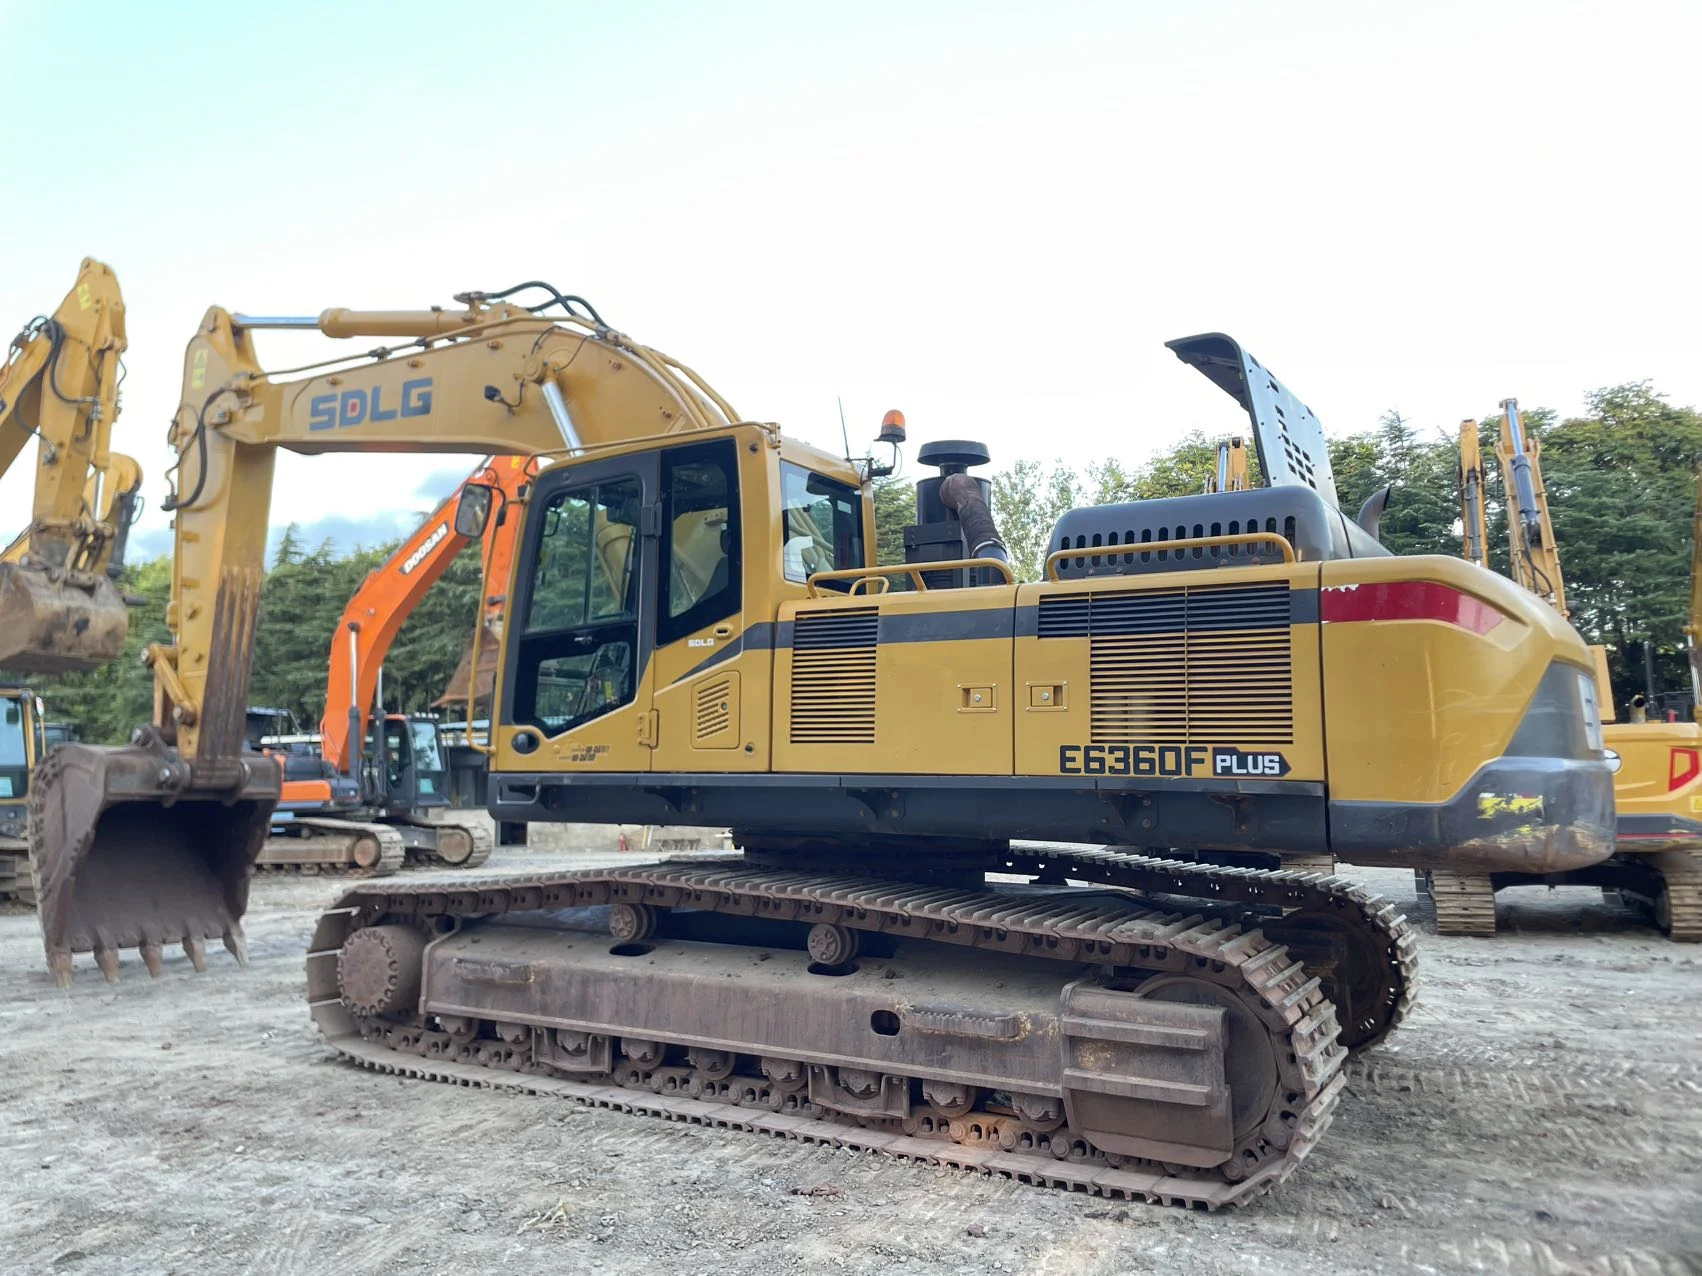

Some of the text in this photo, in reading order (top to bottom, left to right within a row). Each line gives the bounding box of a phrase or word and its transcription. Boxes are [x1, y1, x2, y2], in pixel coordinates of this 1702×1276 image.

[309, 377, 433, 432] SDLG
[403, 523, 448, 574] DOOSAN
[688, 638, 714, 647] SDLG
[1060, 745, 1280, 776] E6360F PLUS
